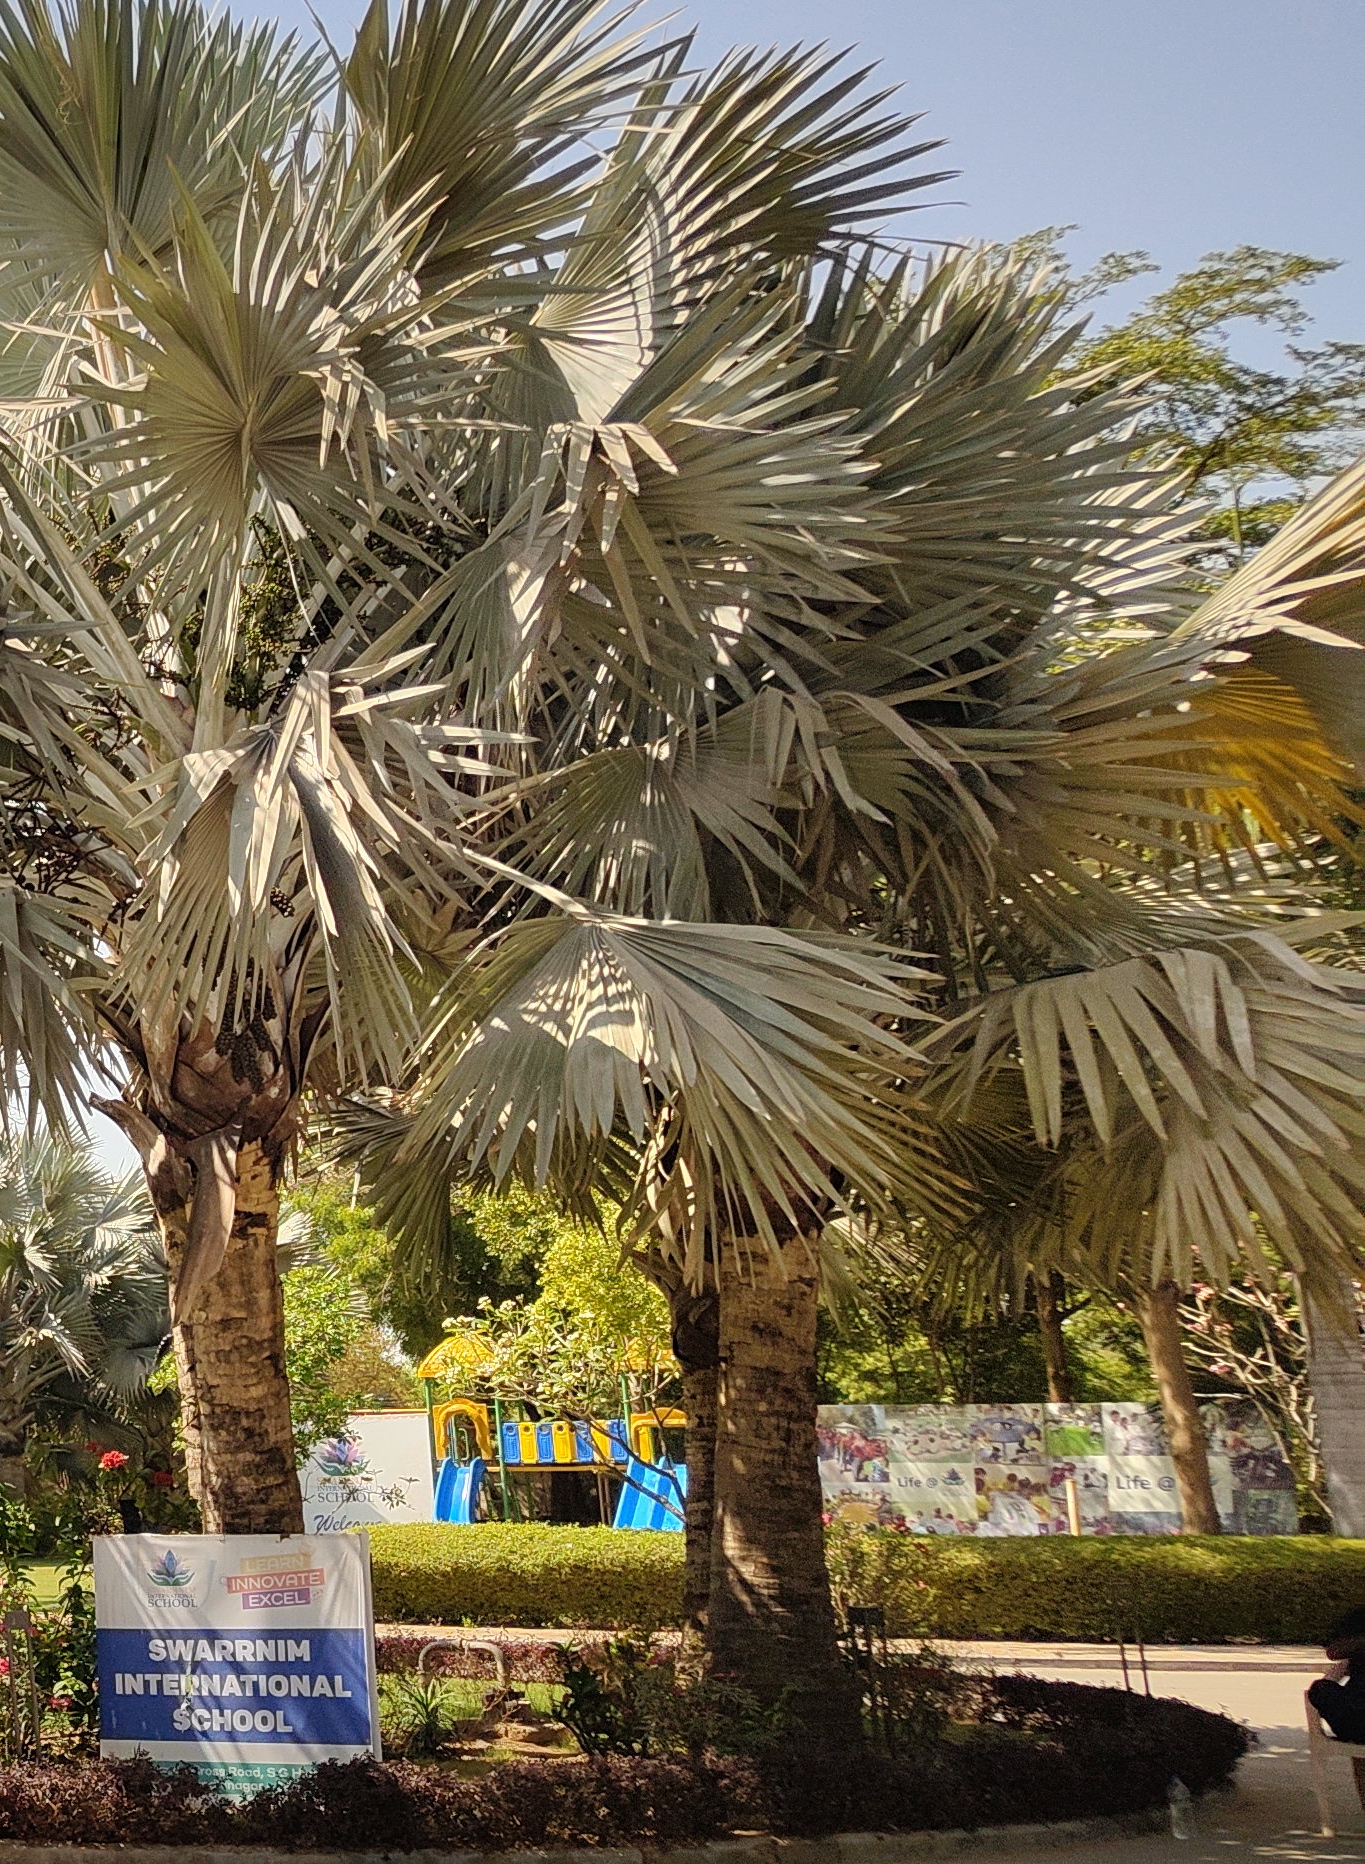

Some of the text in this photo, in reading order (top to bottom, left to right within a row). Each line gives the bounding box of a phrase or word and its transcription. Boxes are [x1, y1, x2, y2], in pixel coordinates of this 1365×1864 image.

[897, 1477, 922, 1488] Life
[1115, 1475, 1151, 1490] Life
[317, 1492, 375, 1503] SCHOL
[246, 1556, 304, 1572] LEARN
[231, 1572, 321, 1591] INNOVATE
[147, 1599, 198, 1608] SCHOOL
[248, 1592, 306, 1607] EXCEL
[148, 1639, 311, 1662] SWARRNIM
[115, 1673, 352, 1698] INTERNATIONAL
[172, 1709, 293, 1733] SCHOOL
[229, 1767, 264, 1779] Road,
